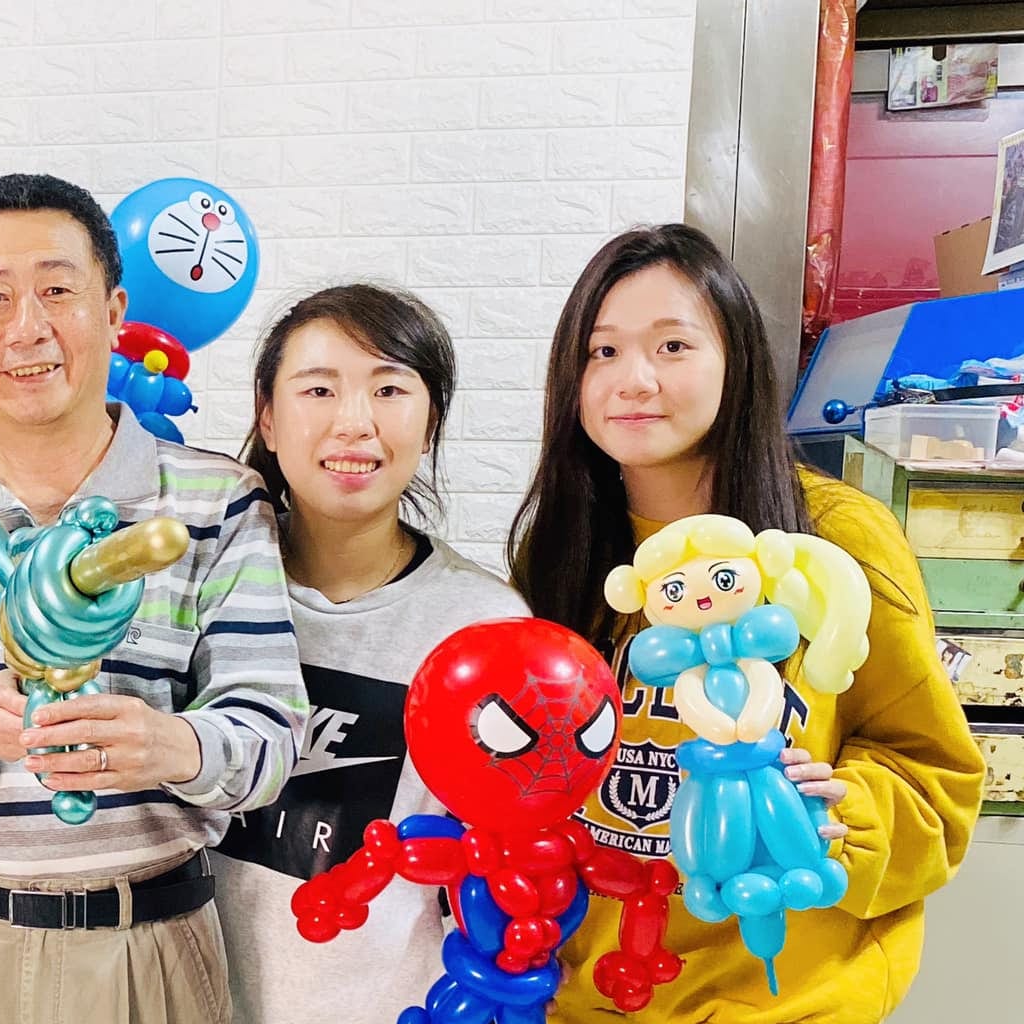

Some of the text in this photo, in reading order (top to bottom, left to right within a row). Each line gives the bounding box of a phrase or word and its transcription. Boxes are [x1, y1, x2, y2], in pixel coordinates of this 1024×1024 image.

[617, 748, 677, 769] USA NYC
[627, 773, 660, 808] M
[584, 824, 652, 853] MERICAN
